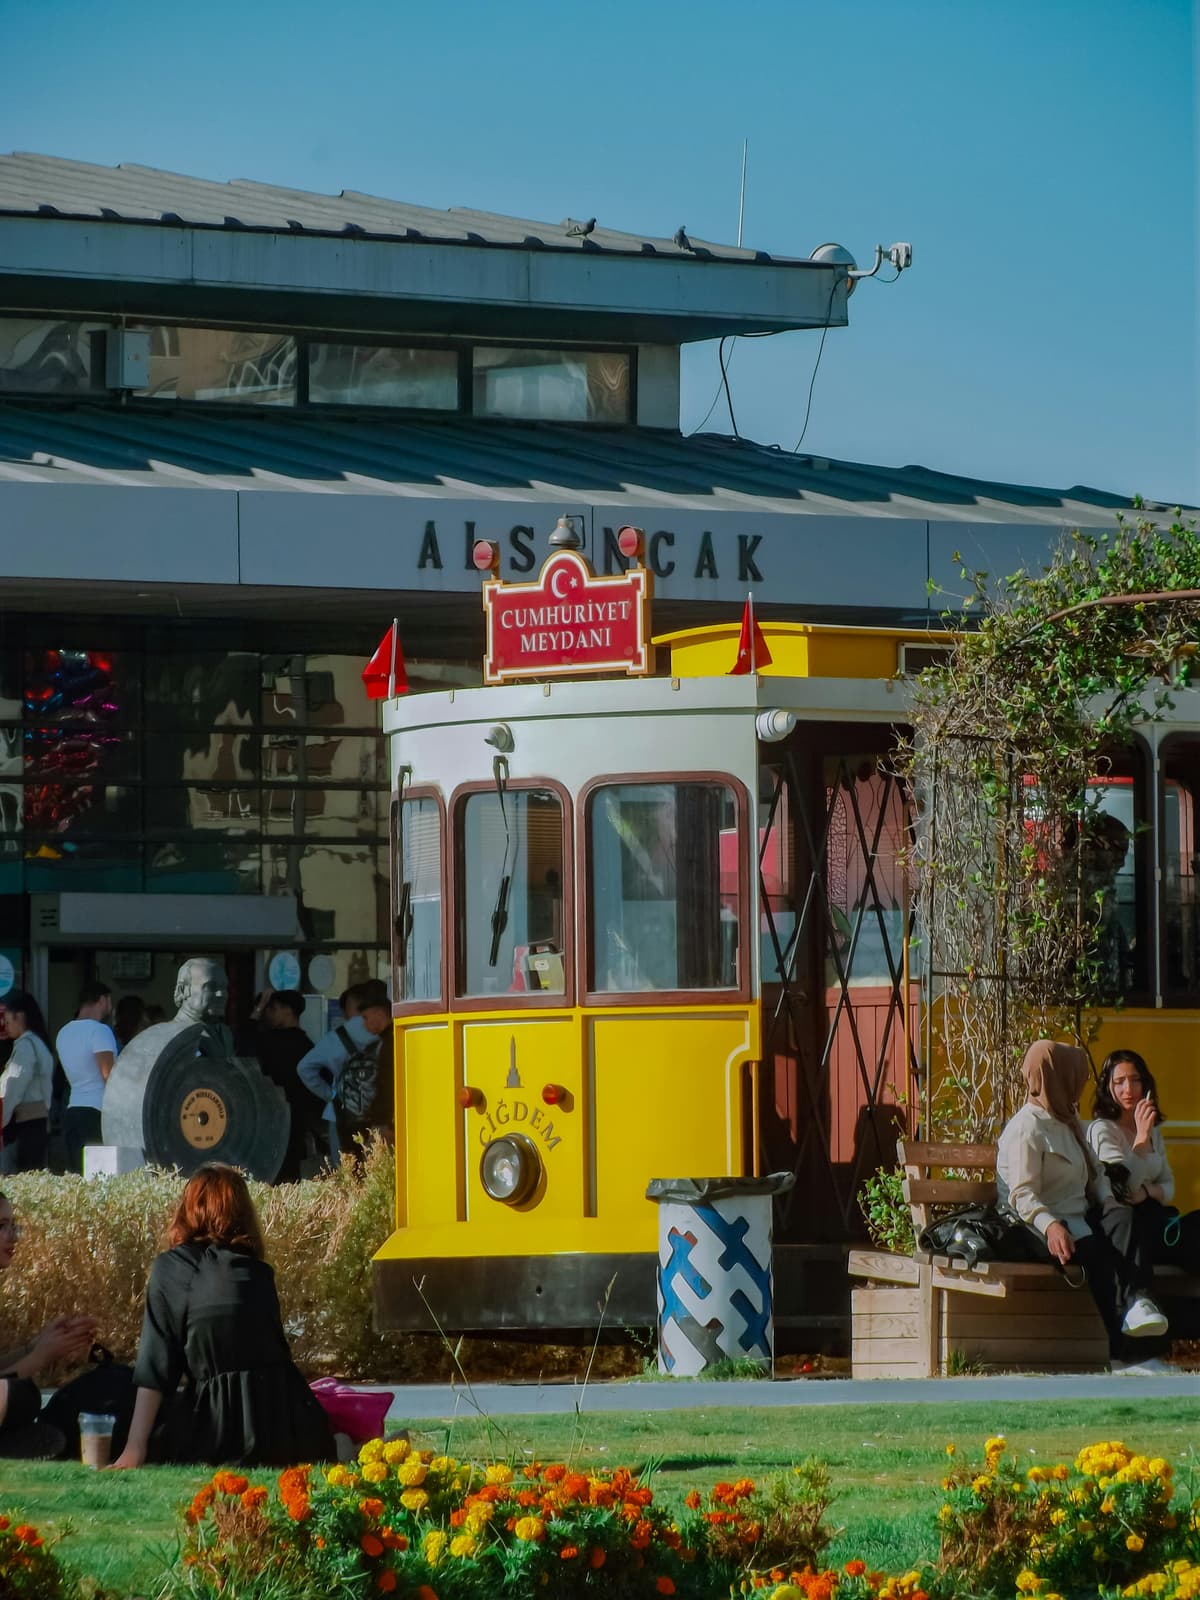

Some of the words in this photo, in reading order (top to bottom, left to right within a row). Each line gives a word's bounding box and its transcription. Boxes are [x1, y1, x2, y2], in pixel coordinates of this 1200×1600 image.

[417, 519, 764, 582] ALSNCAK
[501, 599, 631, 629] CUMHURİYET
[520, 627, 611, 653] MEYDANI
